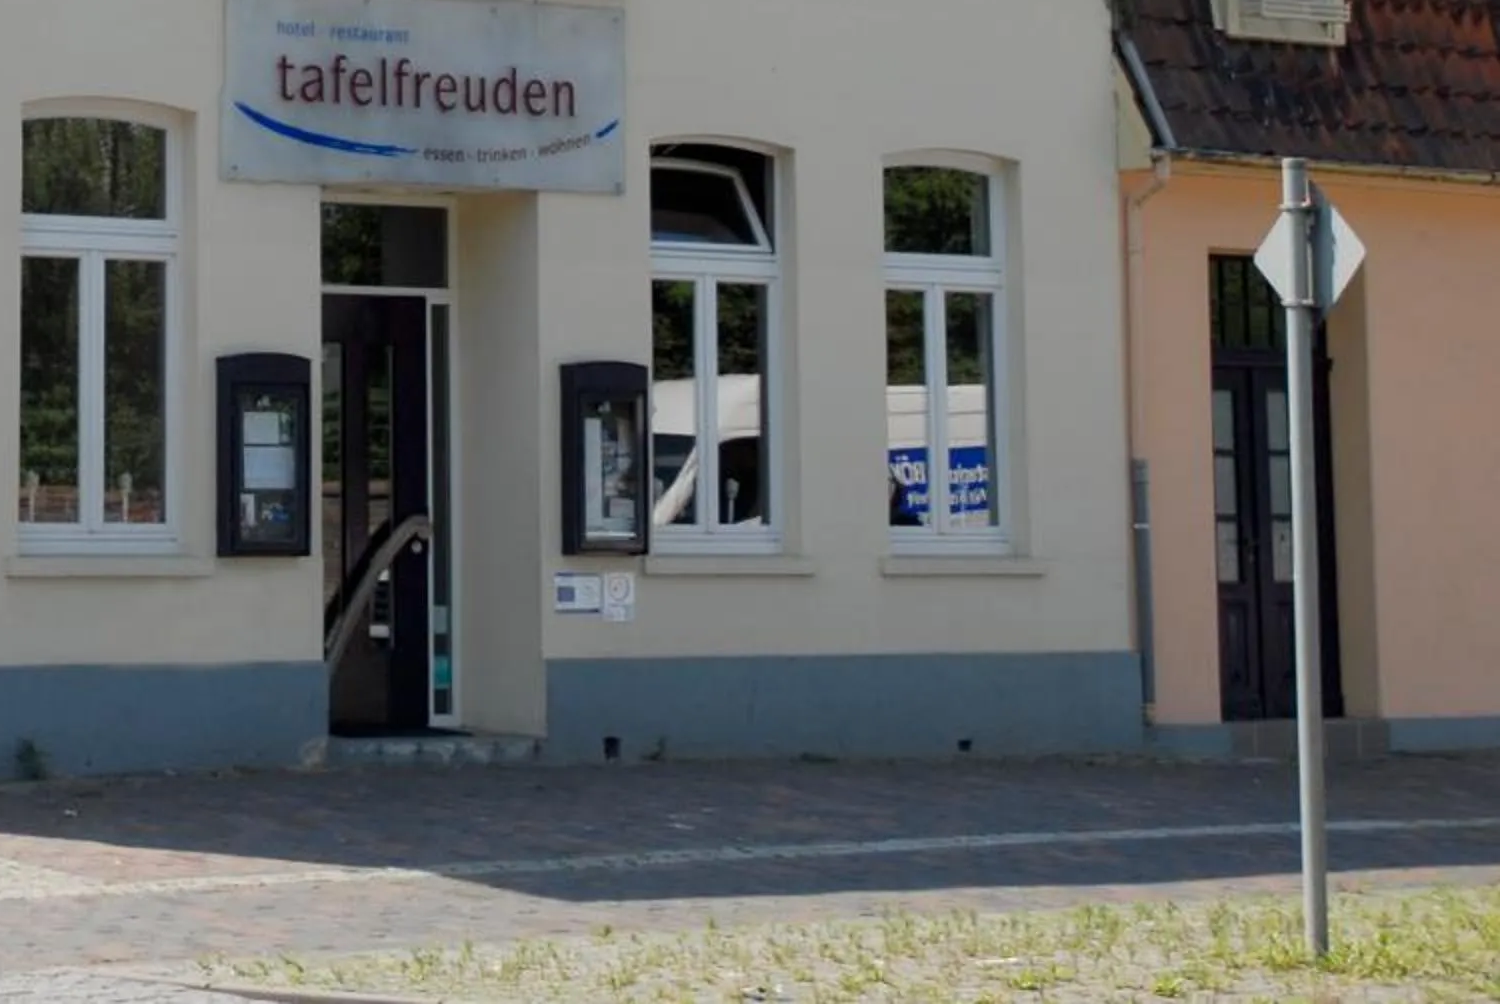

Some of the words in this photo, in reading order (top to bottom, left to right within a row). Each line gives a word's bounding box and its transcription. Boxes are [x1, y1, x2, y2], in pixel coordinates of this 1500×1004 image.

[276, 20, 315, 38] hotel
[329, 22, 410, 44] restaurant
[277, 54, 576, 117] tafelfreuden
[423, 147, 465, 163] essen
[476, 146, 528, 163] trinken
[537, 133, 592, 157] wohnen
